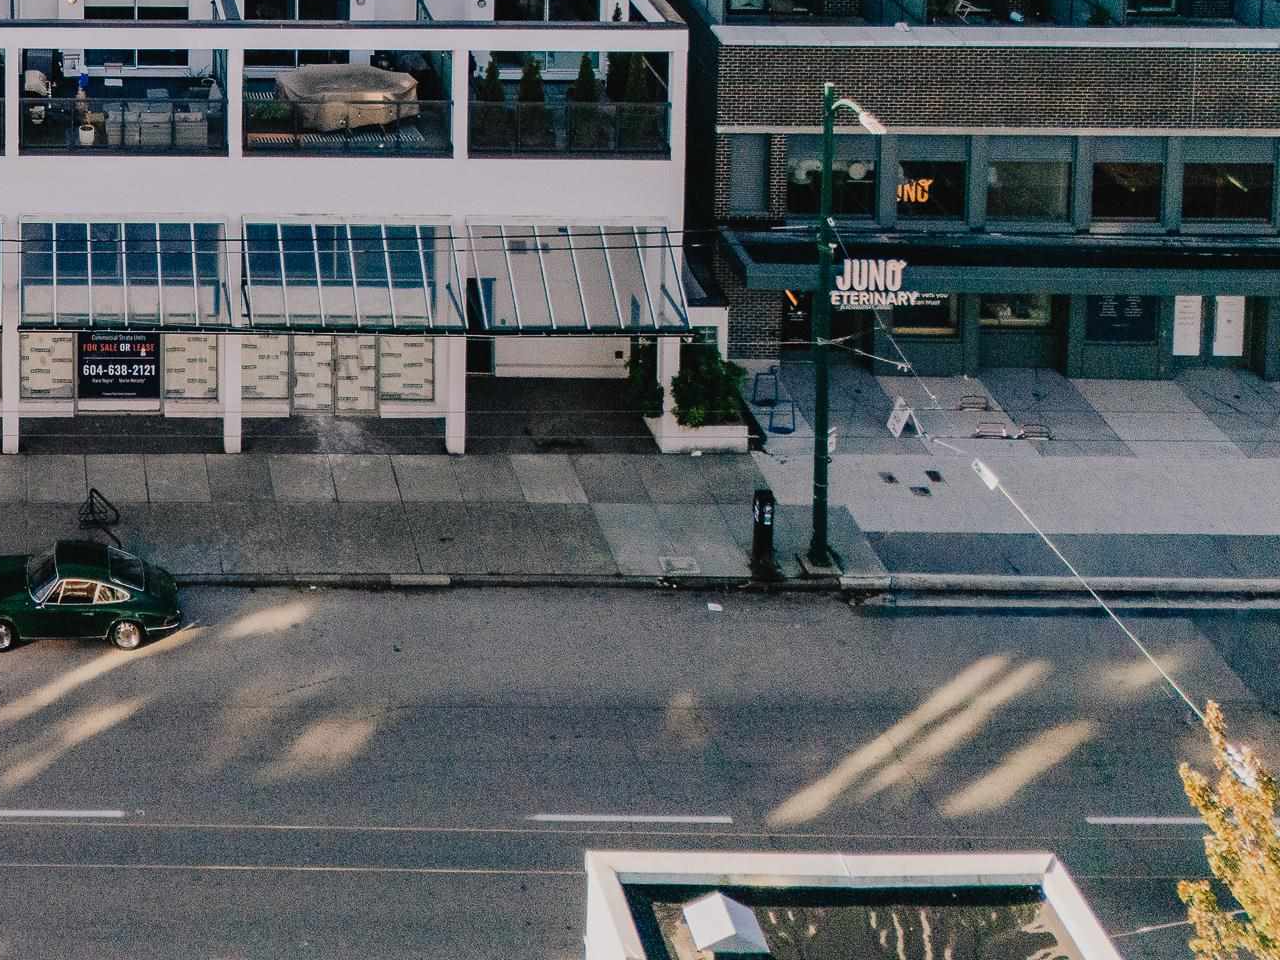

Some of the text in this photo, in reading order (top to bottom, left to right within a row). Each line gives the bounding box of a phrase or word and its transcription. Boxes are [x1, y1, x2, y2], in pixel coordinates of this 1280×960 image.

[835, 258, 908, 291] JUNO
[830, 290, 919, 306] ETERINARY
[82, 343, 156, 352] FOR SALE OR LEASE
[82, 363, 156, 376] 604-638-2121
